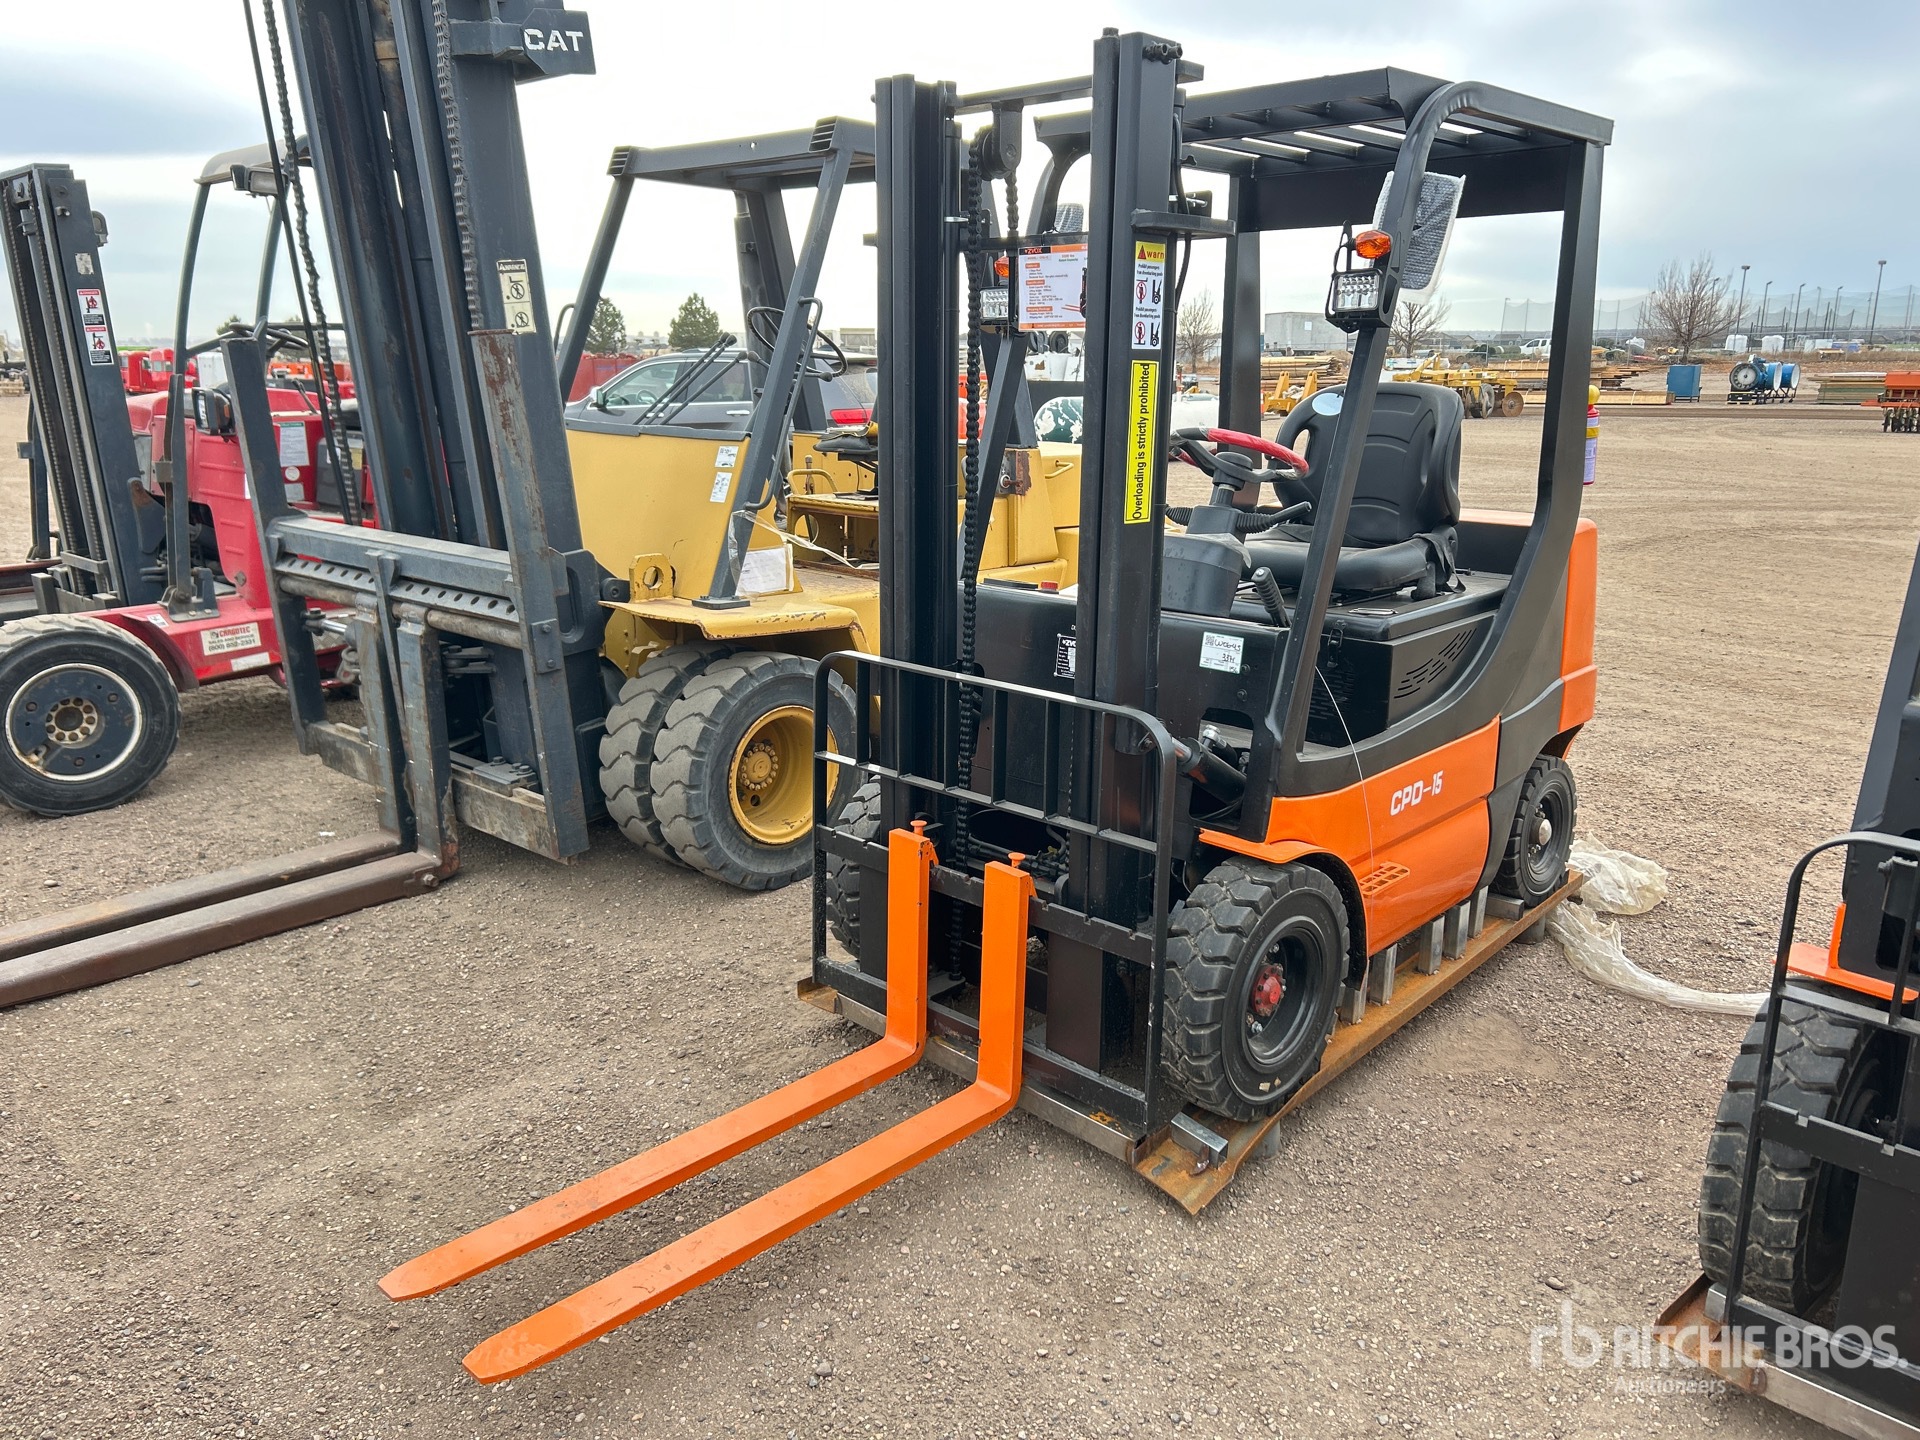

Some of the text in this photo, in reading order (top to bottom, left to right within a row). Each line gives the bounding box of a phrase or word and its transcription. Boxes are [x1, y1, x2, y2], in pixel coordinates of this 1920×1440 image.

[524, 28, 584, 52] CAT
[1146, 250, 1164, 259] warn
[1132, 364, 1150, 520] Overloading is strictly prohibited
[220, 626, 250, 637] CARGOTEC
[1390, 770, 1443, 816] CPD-15
